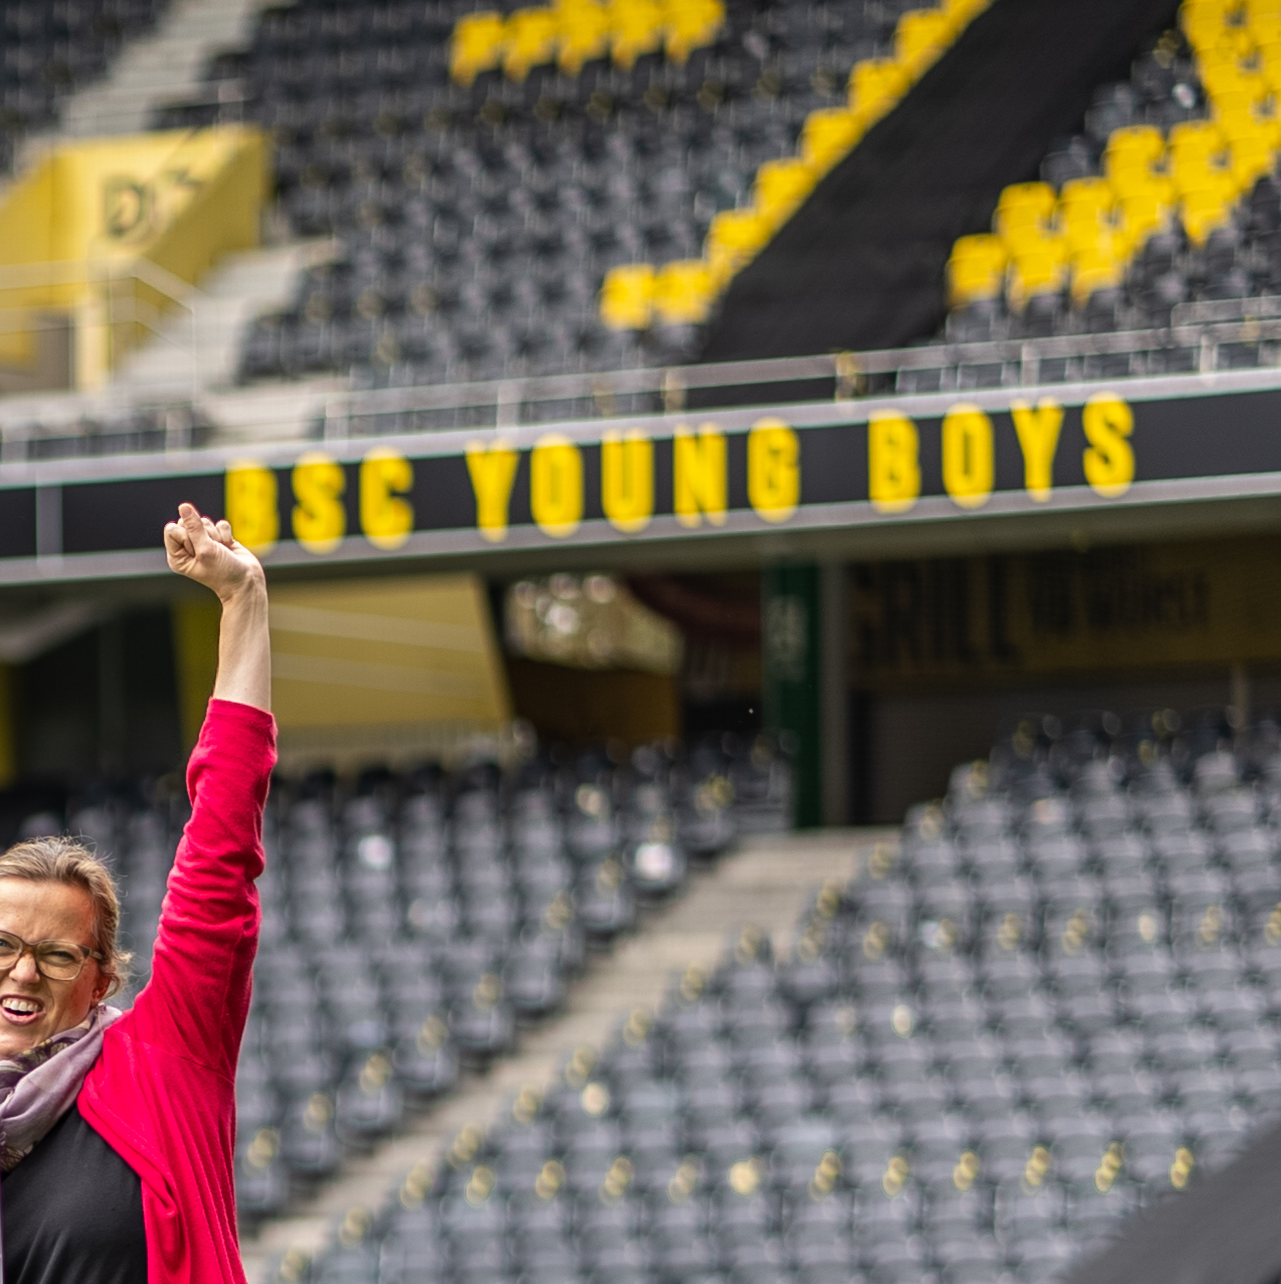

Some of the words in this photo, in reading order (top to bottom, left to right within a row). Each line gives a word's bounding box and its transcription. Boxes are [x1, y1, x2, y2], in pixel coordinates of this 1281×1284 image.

[224, 447, 415, 556] BSC
[463, 417, 801, 543] YOUNG
[868, 390, 1135, 514] BOYS
